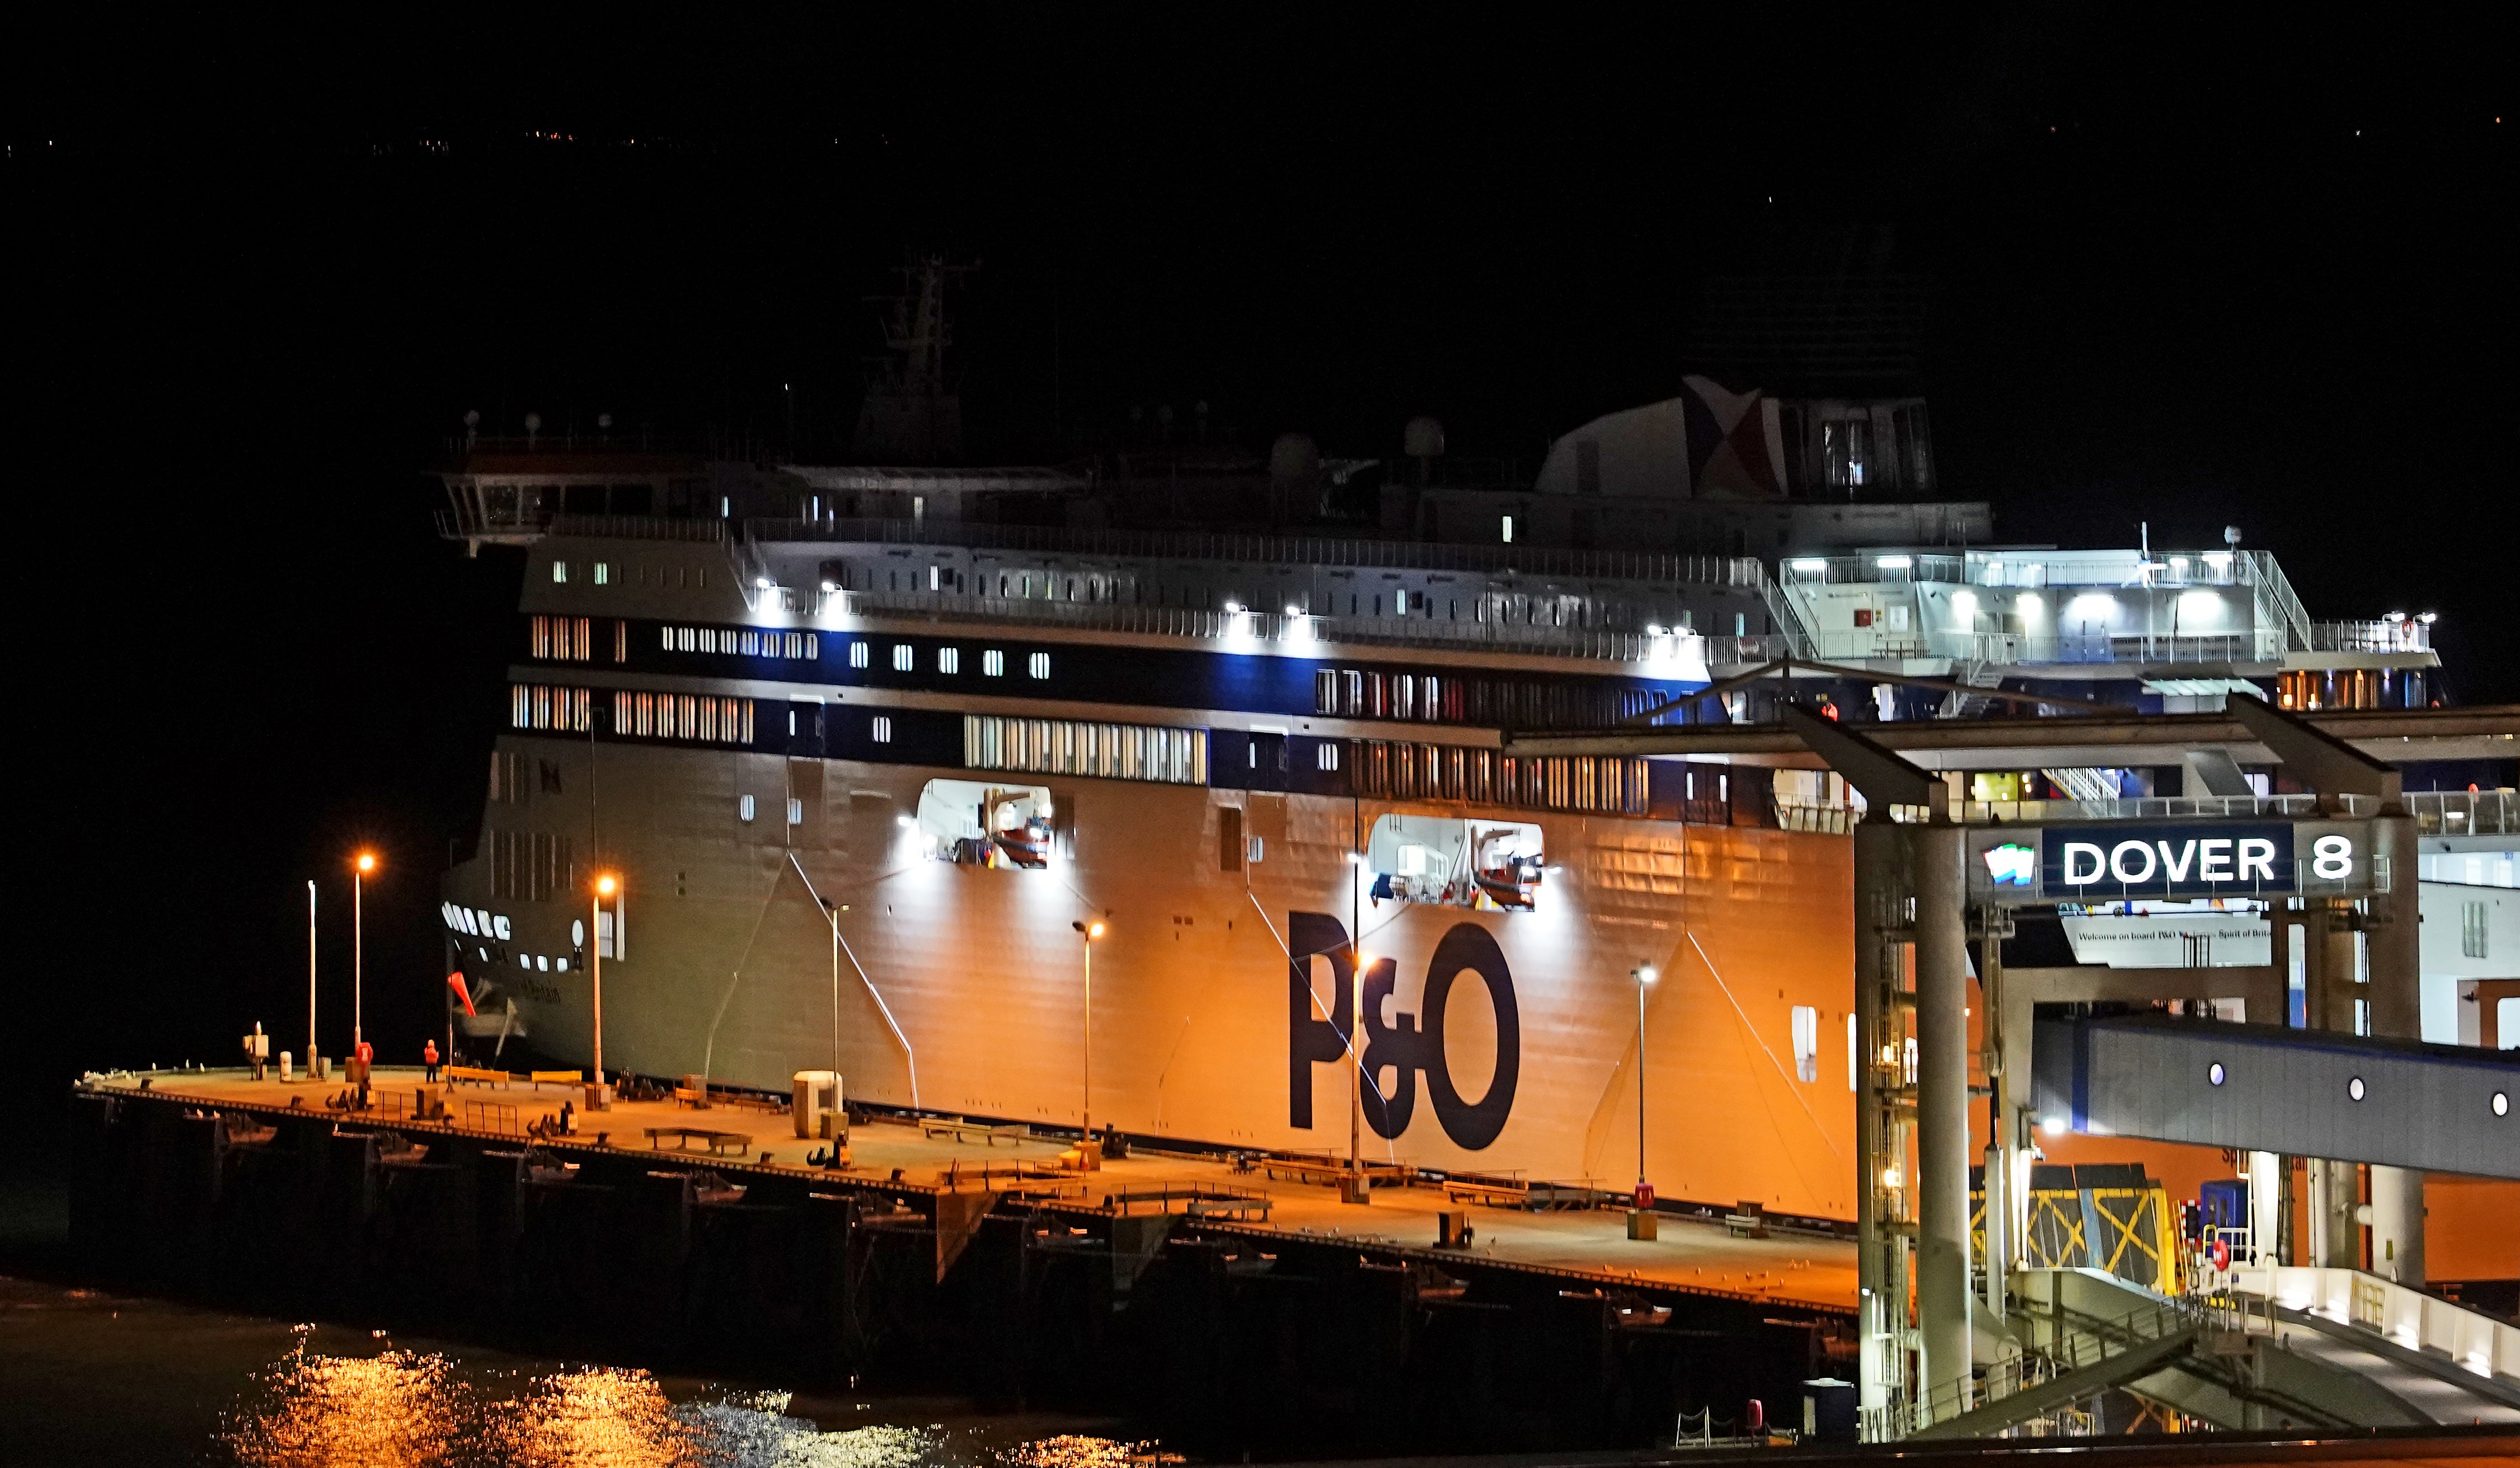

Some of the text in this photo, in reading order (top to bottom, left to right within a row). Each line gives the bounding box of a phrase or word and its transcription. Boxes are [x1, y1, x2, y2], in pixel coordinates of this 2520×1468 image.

[2063, 834, 2353, 885] DOVER 8
[2078, 931, 2117, 941] Welcome
[2131, 930, 2155, 941] board
[2218, 928, 2241, 941] Spirit
[2242, 929, 2250, 939] of
[1288, 909, 1520, 1151] P&O
